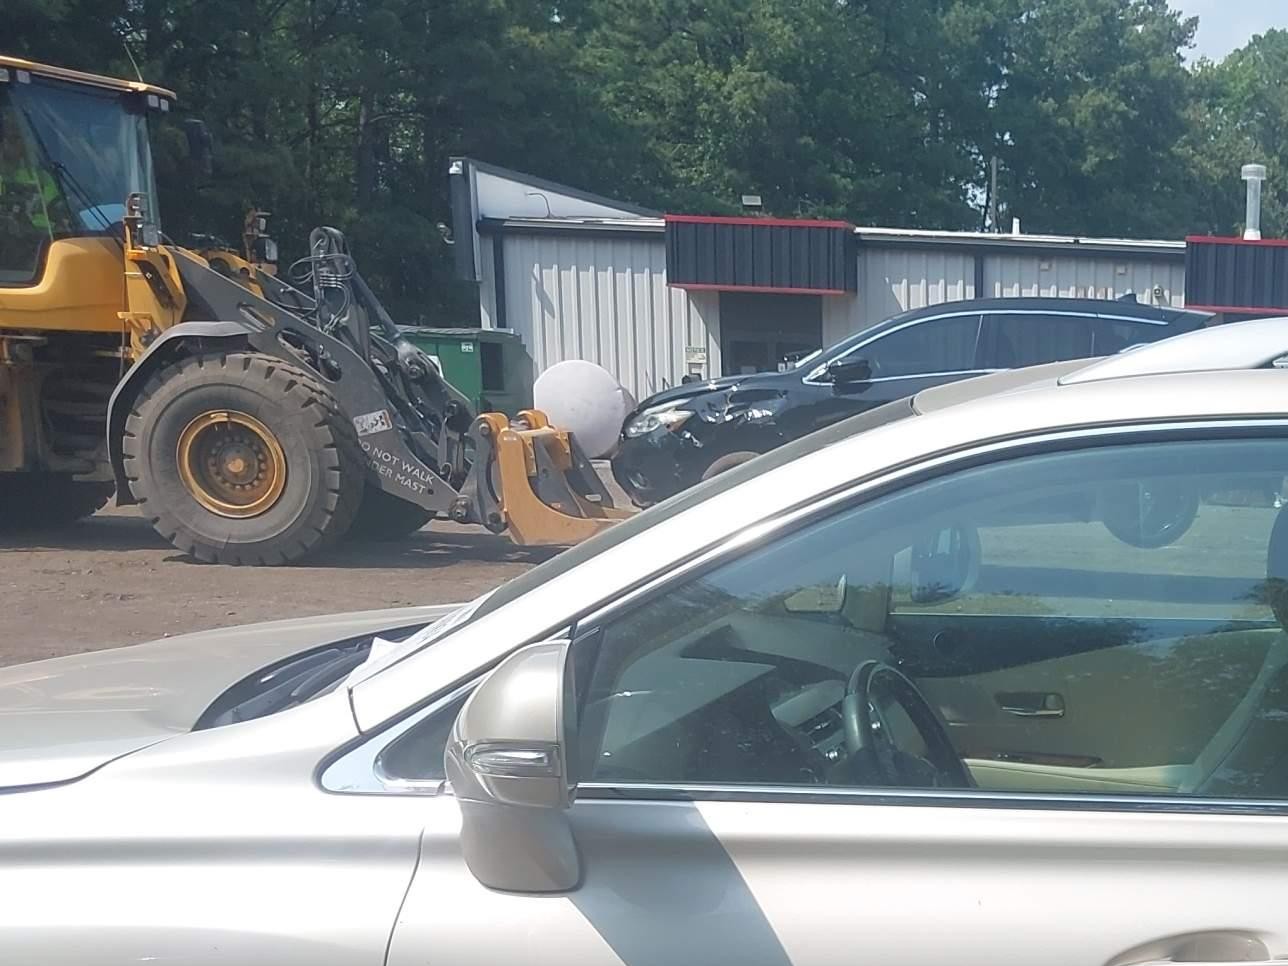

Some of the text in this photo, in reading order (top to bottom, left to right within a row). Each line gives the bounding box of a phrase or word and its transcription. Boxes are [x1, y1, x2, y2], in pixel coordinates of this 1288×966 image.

[358, 438, 434, 485] O NOT WALK
[395, 473, 426, 495] MAST
